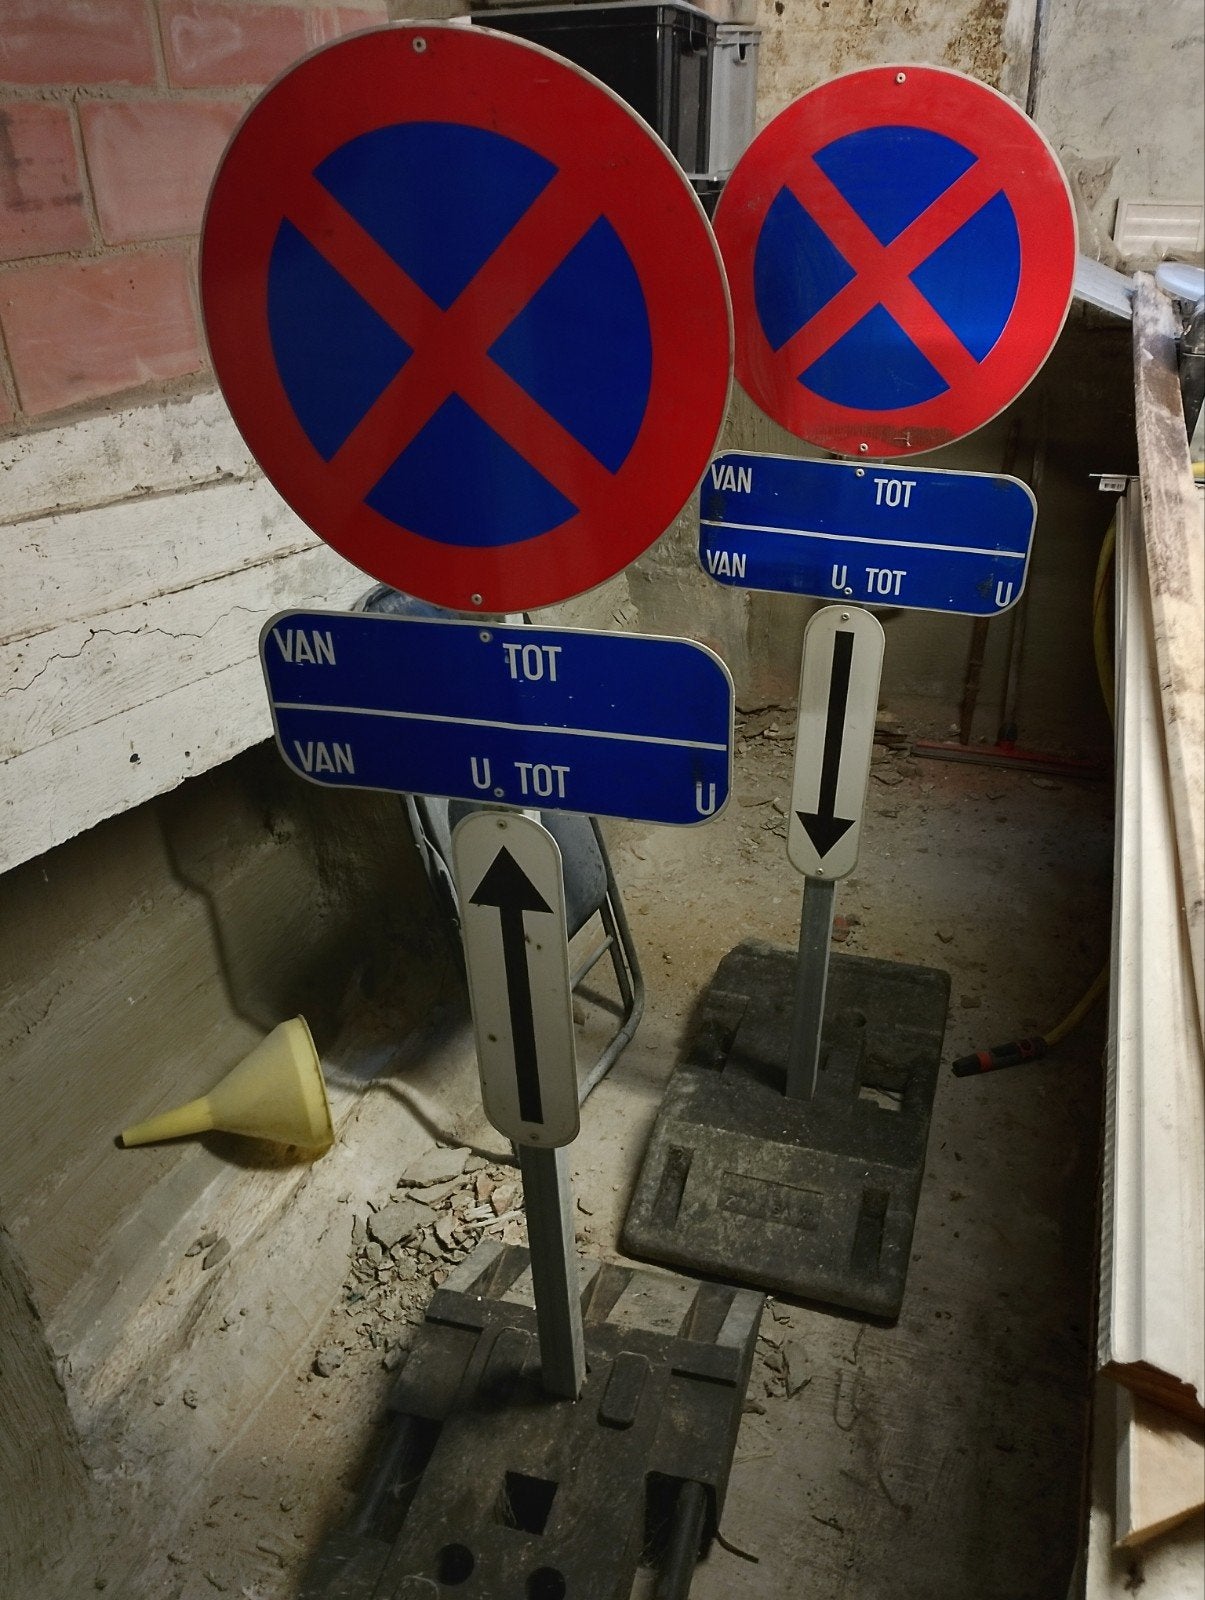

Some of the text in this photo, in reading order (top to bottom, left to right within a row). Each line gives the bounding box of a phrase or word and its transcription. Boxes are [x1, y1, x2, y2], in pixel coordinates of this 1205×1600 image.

[711, 464, 917, 508] VAN TOT
[706, 549, 1013, 608] VAN U TOT U
[273, 628, 562, 682] VAN TOT
[294, 740, 716, 816] VAN U TOT U
